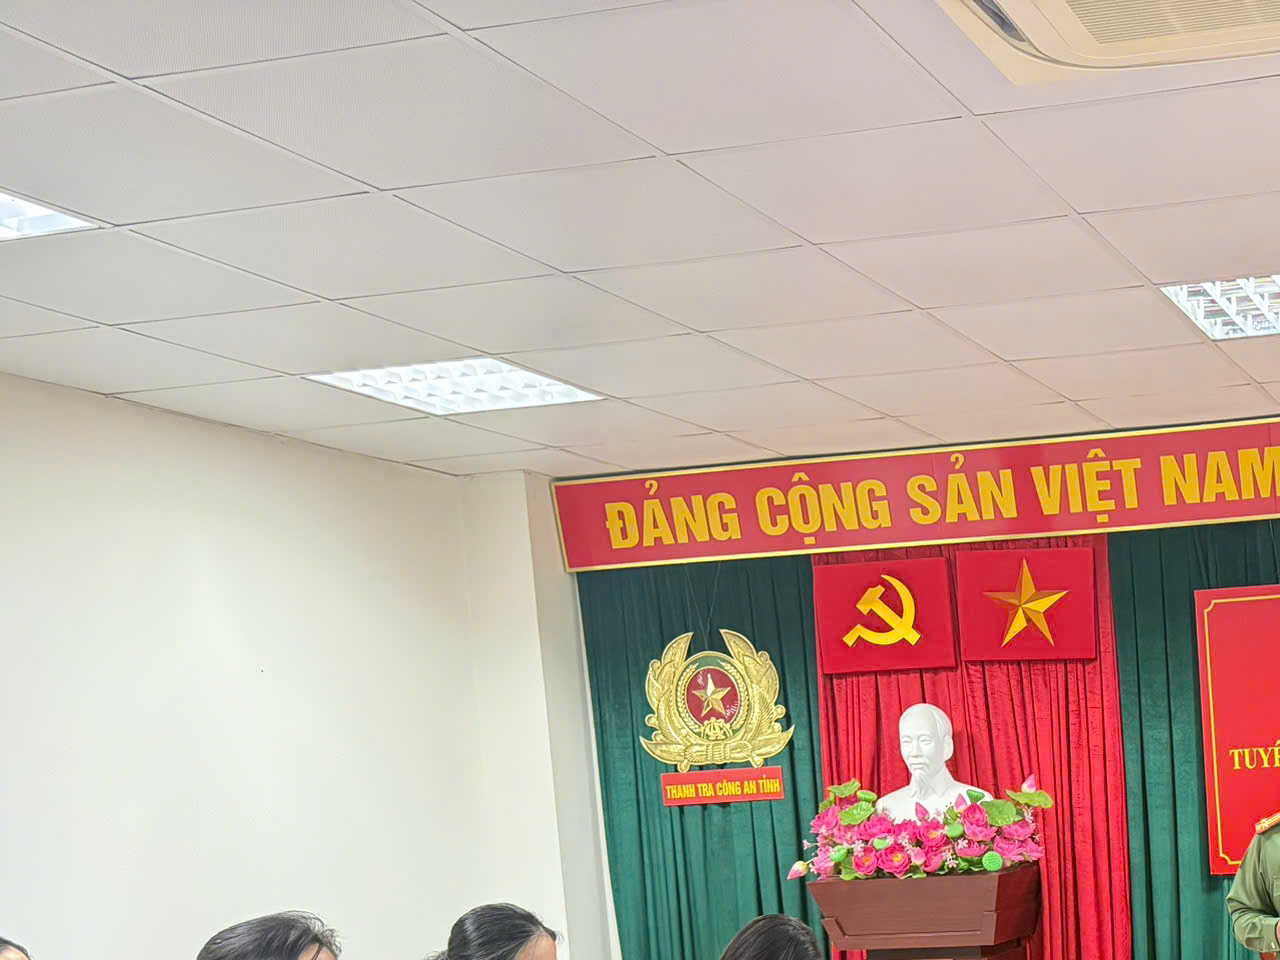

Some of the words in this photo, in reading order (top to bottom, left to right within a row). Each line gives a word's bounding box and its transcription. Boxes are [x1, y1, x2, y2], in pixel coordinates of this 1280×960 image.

[606, 480, 740, 549] ĐẢNG
[757, 472, 891, 545] CỘNG
[909, 452, 1016, 525] SẢN
[1031, 448, 1143, 522] VIỆT
[665, 784, 696, 799] THANH
[697, 783, 714, 797] TRA
[716, 779, 741, 796] CÔNG
[744, 780, 757, 795] AN
[758, 775, 781, 793] TỈNH
